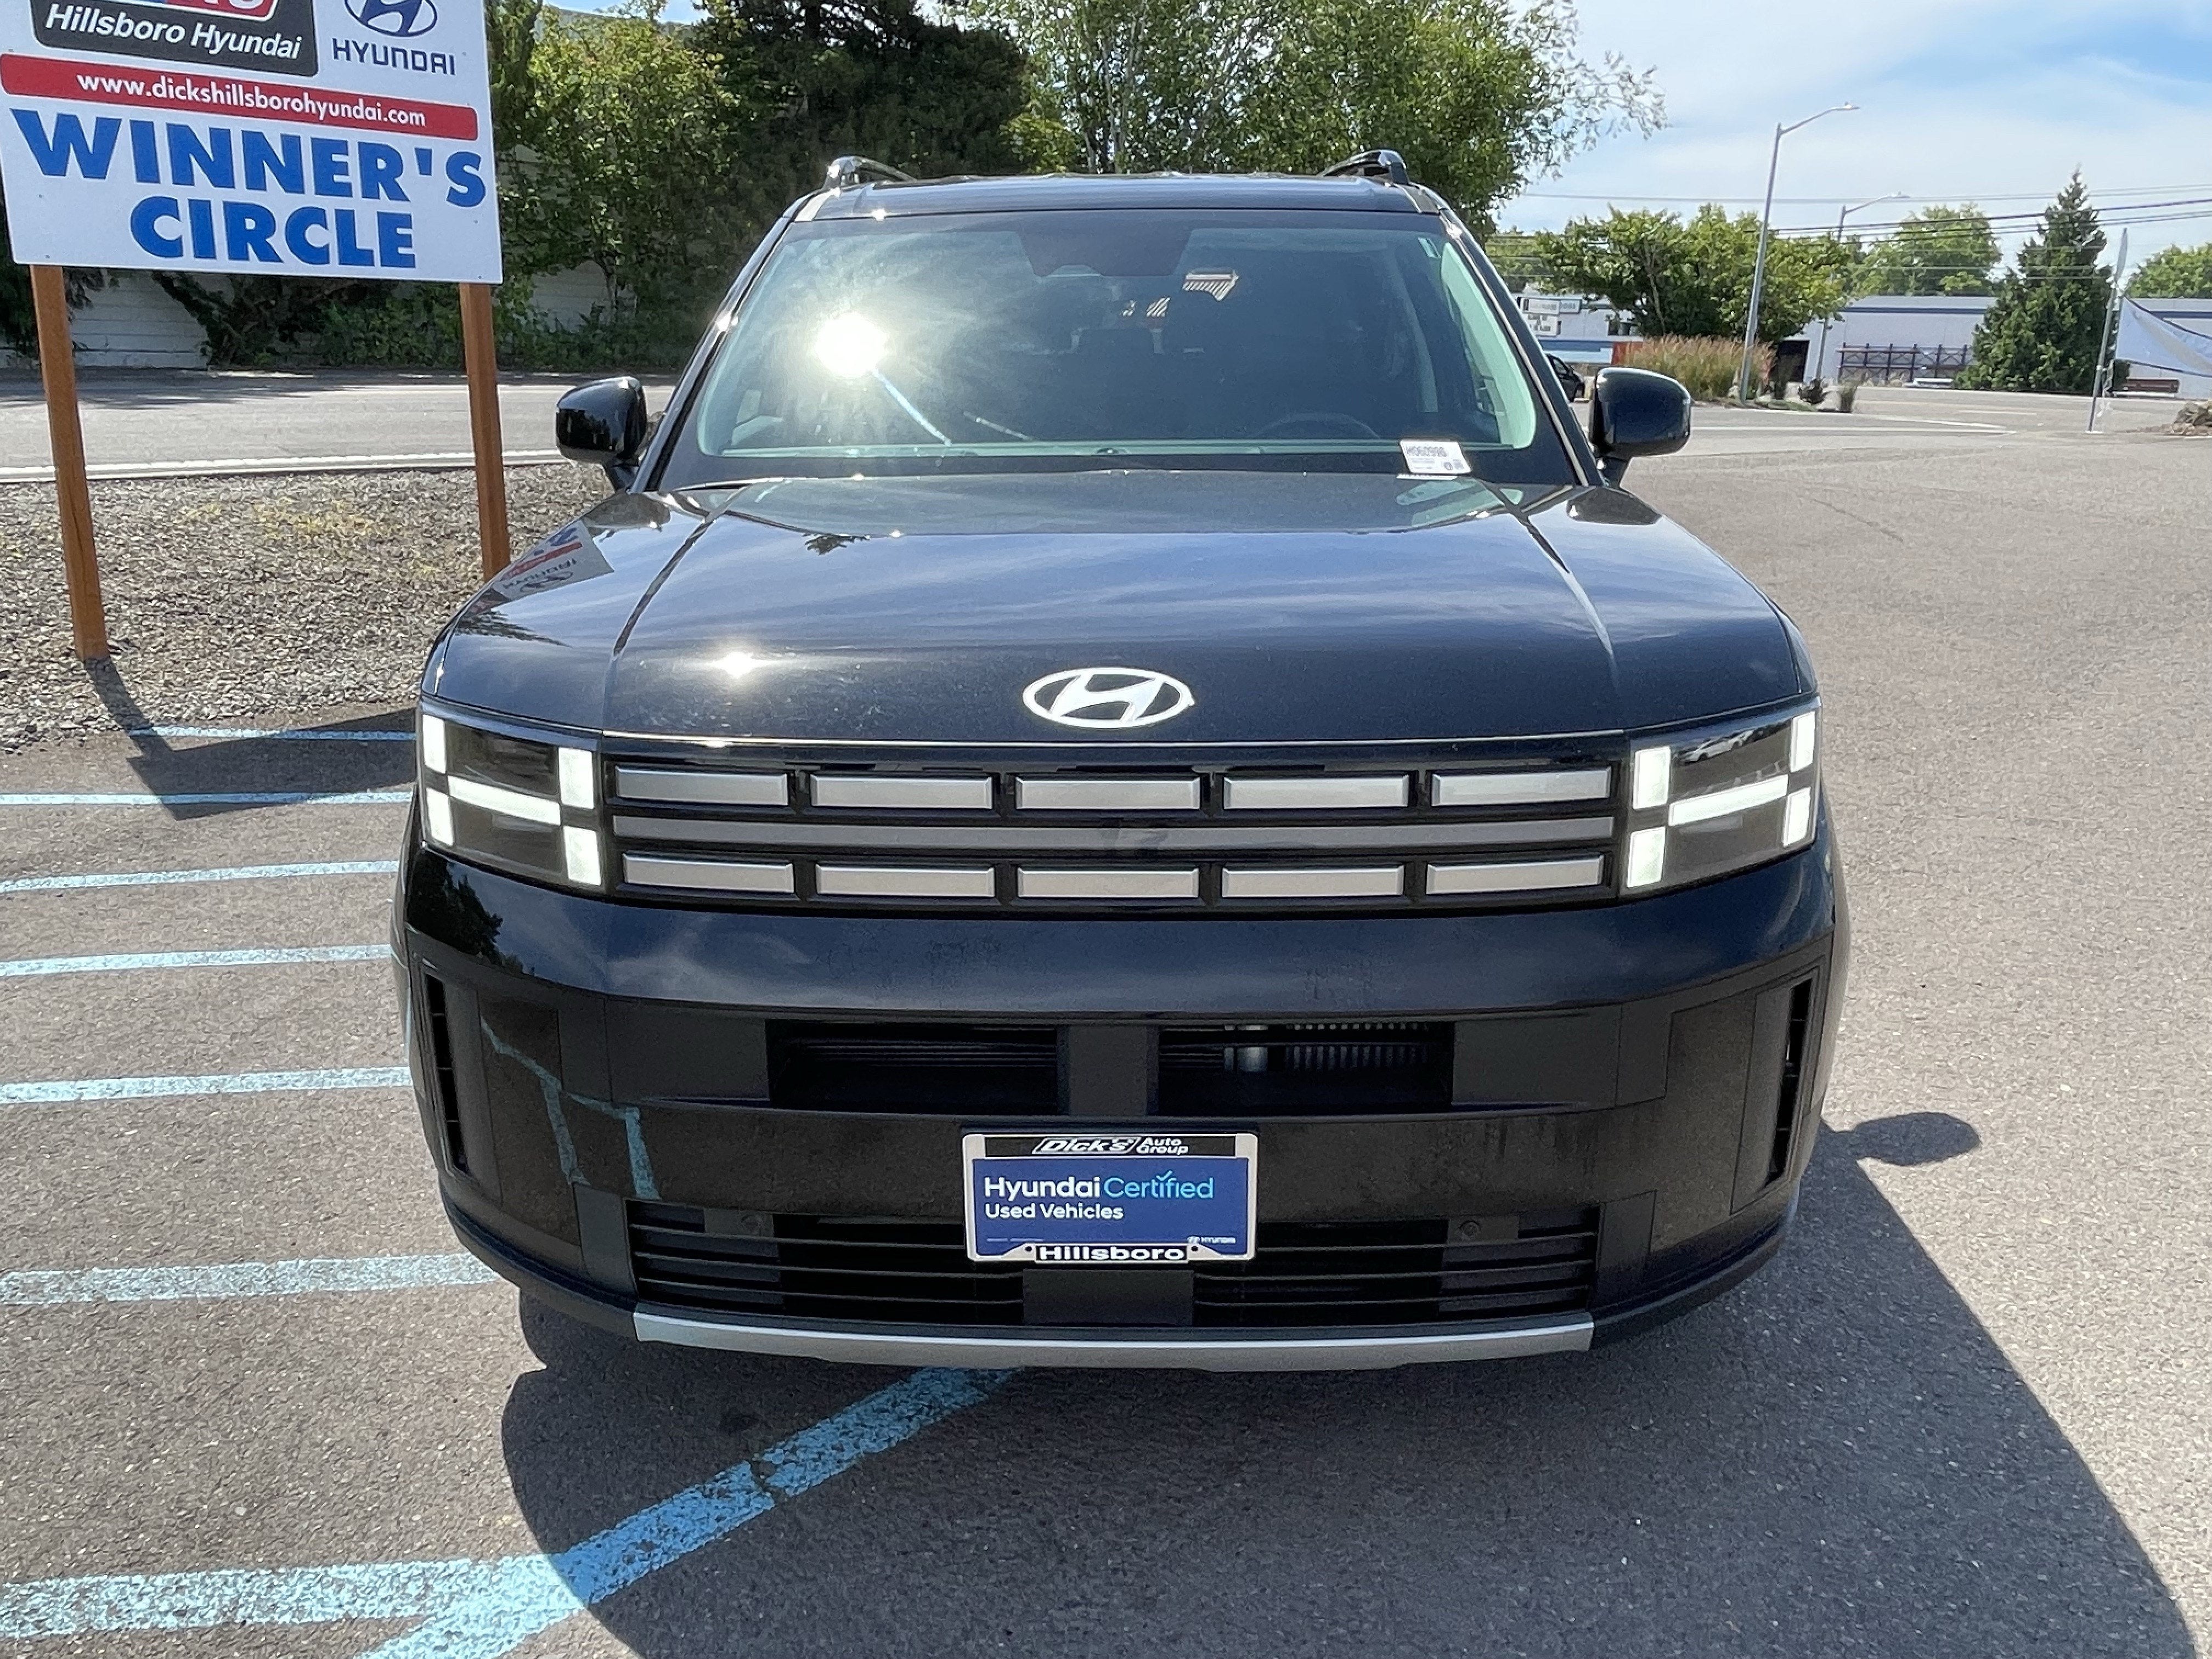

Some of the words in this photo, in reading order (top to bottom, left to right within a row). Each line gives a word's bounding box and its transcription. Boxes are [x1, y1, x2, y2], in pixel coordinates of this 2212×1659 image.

[45, 3, 185, 44] Hillsboro
[190, 22, 303, 59] Hyundai
[332, 38, 456, 76] HYUNDAI
[77, 74, 426, 127] www.dickshillsborohyundai.com
[9, 108, 487, 208] WINNER'S
[130, 195, 417, 269] CIRCLE
[1137, 1145, 1188, 1155] Group
[1141, 1137, 1182, 1147] Auto
[984, 1176, 1101, 1201] Hyundai
[1103, 1171, 1214, 1199] Certified
[985, 1204, 1036, 1219] Used
[1040, 1203, 1124, 1219] Vehicles
[1039, 1245, 1185, 1260] Hillsboro
